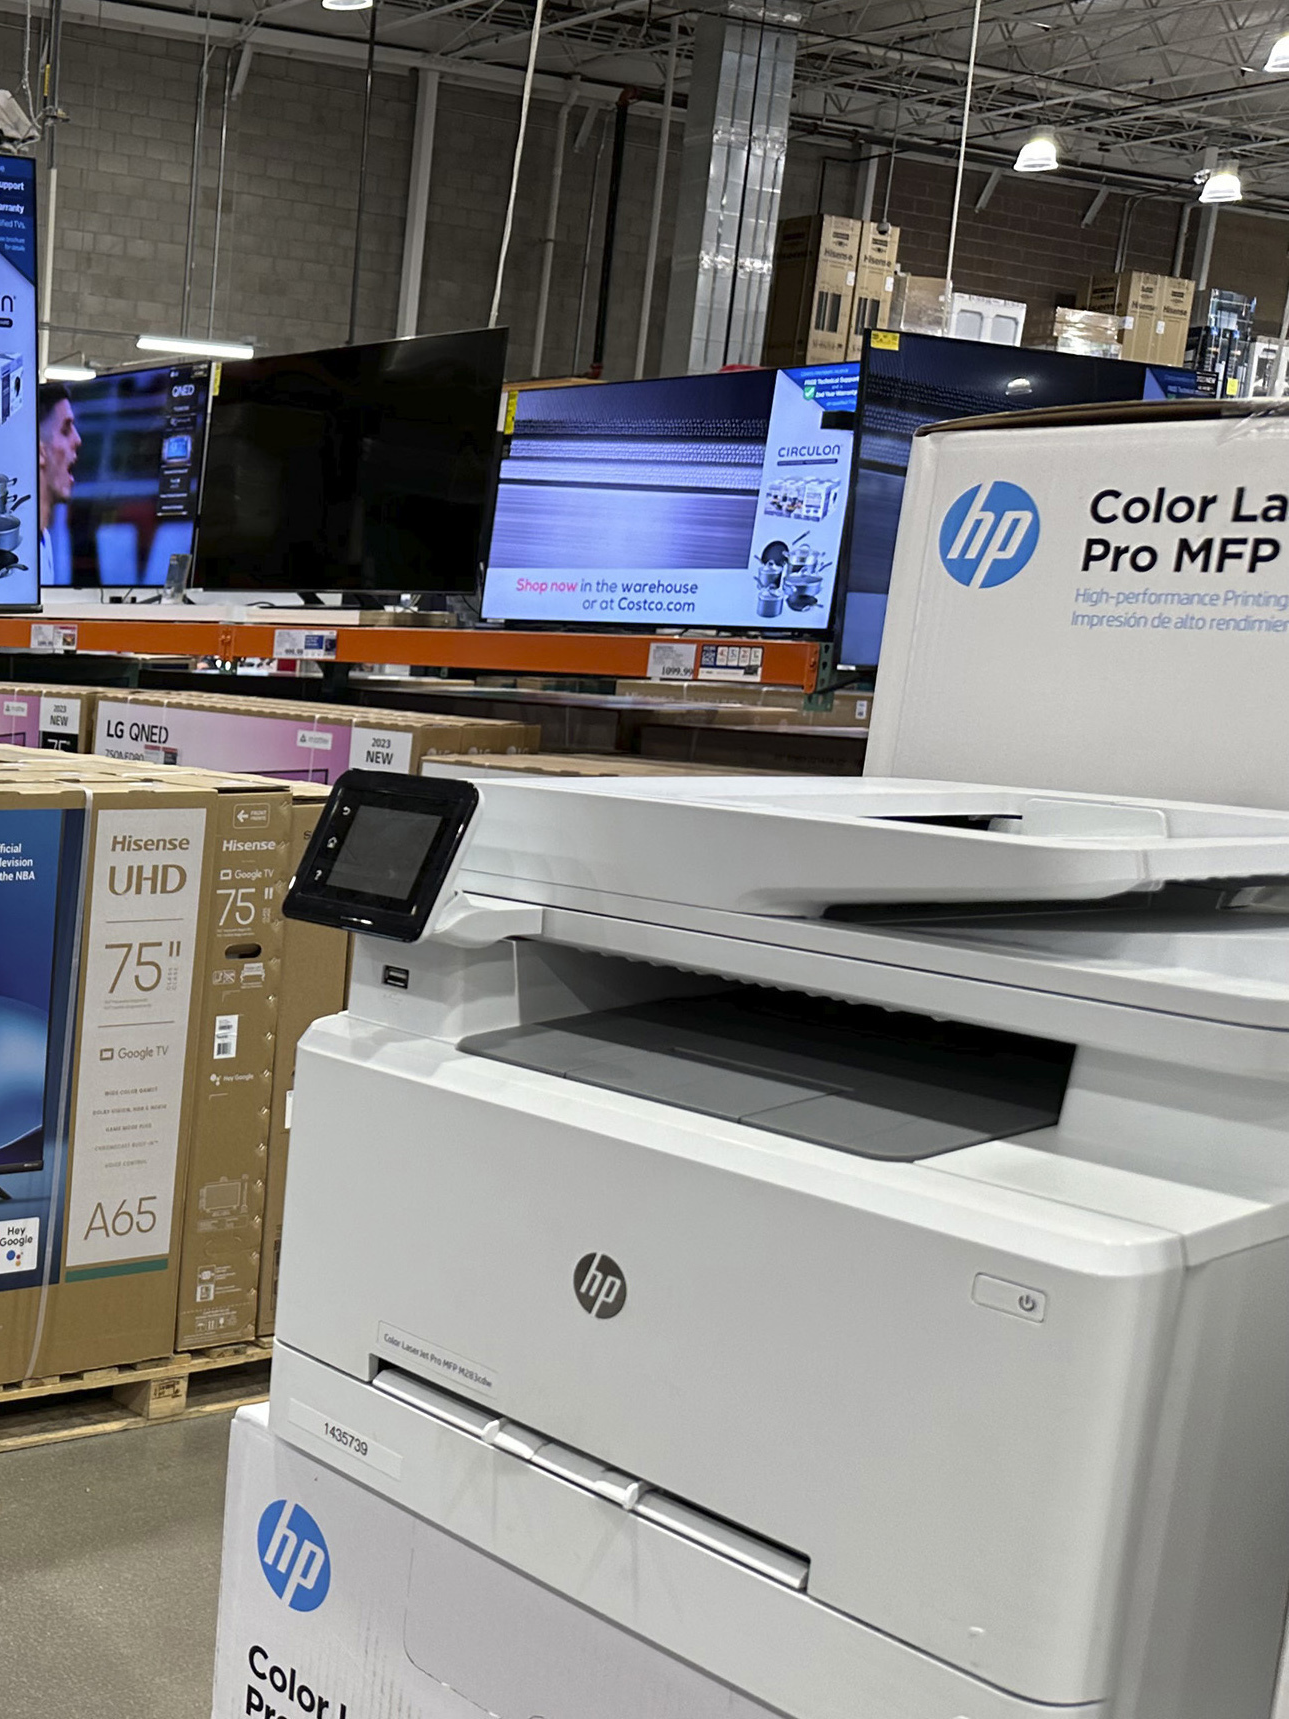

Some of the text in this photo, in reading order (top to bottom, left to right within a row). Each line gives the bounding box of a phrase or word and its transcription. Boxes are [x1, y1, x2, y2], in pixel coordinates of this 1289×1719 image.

[863, 254, 892, 268] Hisense
[1163, 306, 1188, 316] Hisense
[172, 384, 195, 398] QNED
[778, 444, 840, 458] CIRCULON
[1090, 487, 1217, 524] Color
[939, 481, 1040, 588] hp
[1081, 537, 1280, 574] Pro MFP
[516, 578, 698, 594] Shop now in the warehouse
[582, 597, 695, 612] or at Costco.com
[1074, 588, 1221, 607] High-performance
[1071, 610, 1147, 633] Impresión
[1150, 613, 1172, 631] de
[1174, 614, 1206, 632] alto
[661, 666, 694, 676] 1099.99
[50, 715, 69, 726] NEW
[106, 720, 169, 744] LG QNED
[371, 737, 391, 749] 2023
[365, 750, 393, 765] NEW
[111, 834, 190, 852] Hisense
[222, 839, 276, 852] Hisense
[0, 871, 14, 881] the
[15, 870, 35, 881] NBA
[108, 864, 187, 896] UHD
[234, 869, 274, 881] Google TV
[216, 887, 273, 926] 75"
[105, 941, 181, 994] 75"
[117, 1045, 169, 1060] Google TV
[83, 1195, 158, 1241] A65
[7, 1227, 26, 1236] Hey
[0, 1235, 33, 1247] Google
[573, 1252, 627, 1319] hp
[383, 1333, 400, 1347] Color
[430, 1353, 442, 1366] Pro
[443, 1359, 458, 1371] MFP
[323, 1422, 369, 1456] 1435739
[257, 1500, 331, 1612] hp
[248, 1645, 329, 1713] Color
